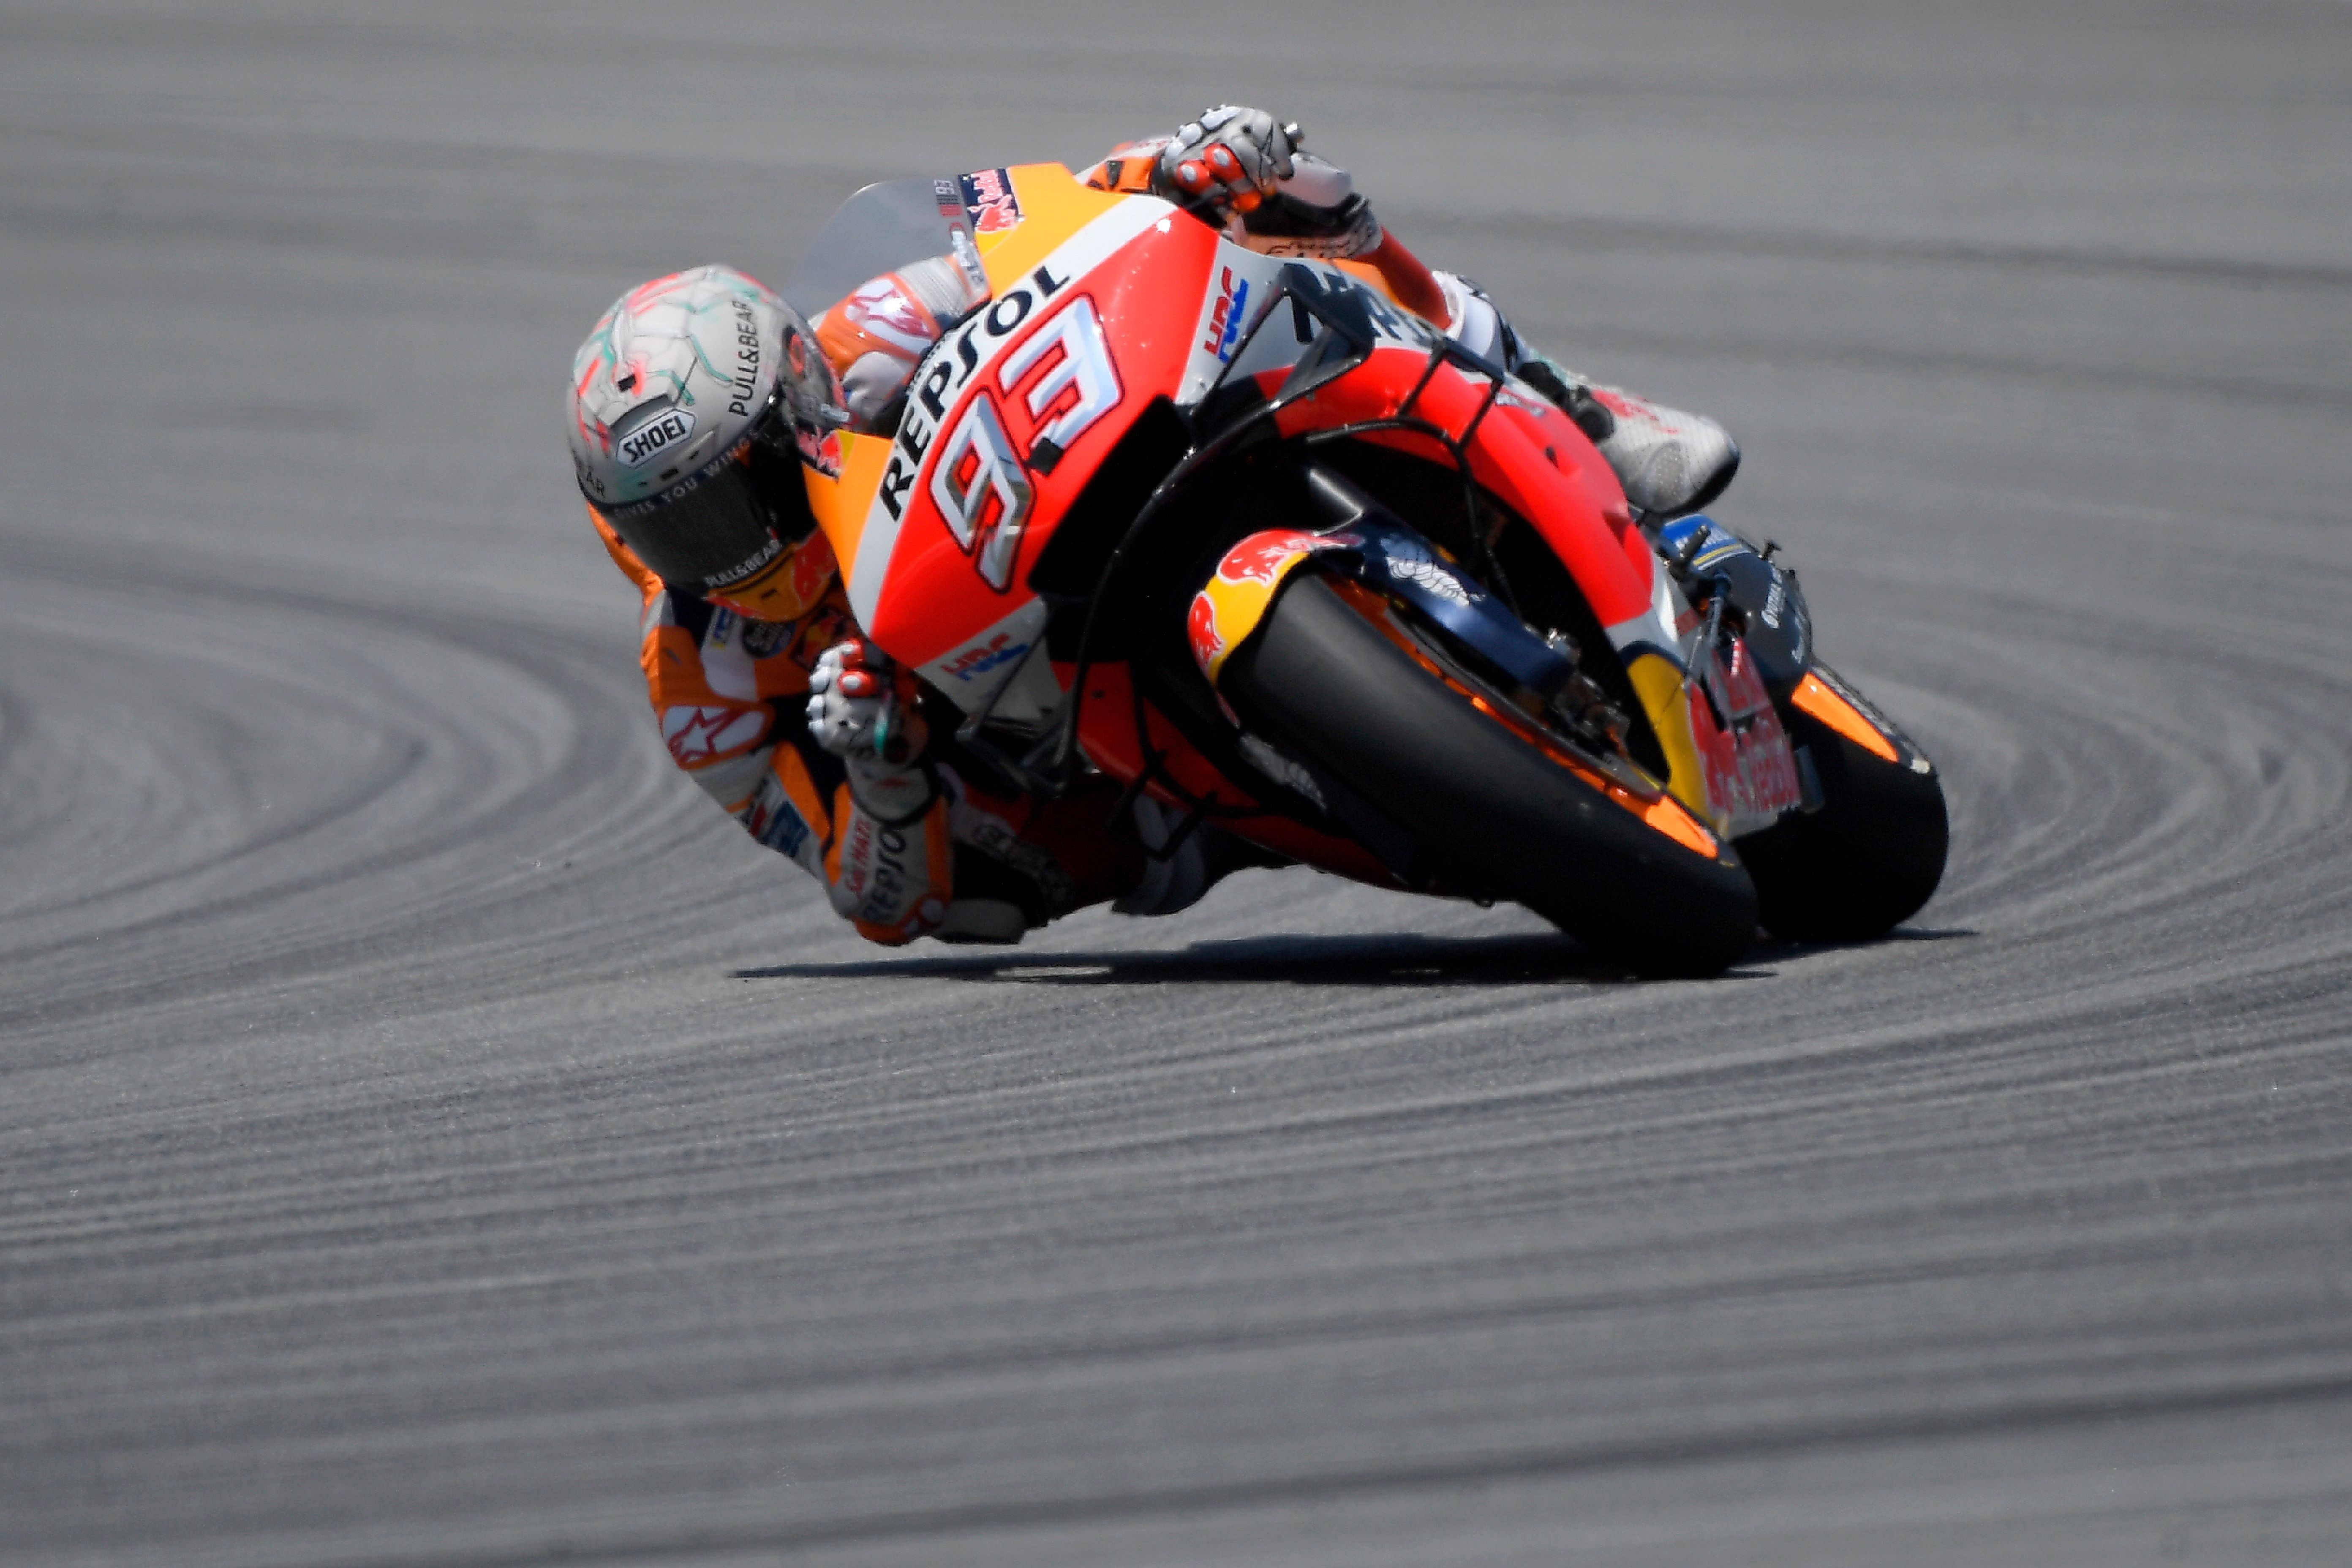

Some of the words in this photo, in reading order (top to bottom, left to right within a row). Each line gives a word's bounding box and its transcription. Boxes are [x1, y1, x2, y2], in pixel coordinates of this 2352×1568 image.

[729, 299, 759, 417] PULL&BEAR
[1204, 266, 1249, 364] HRC
[623, 415, 686, 463] SHOEI
[880, 265, 1070, 522] REPSOL
[660, 476, 697, 503] YOU
[930, 292, 1124, 593] 93
[703, 539, 782, 587] PULL&BEAR
[864, 827, 906, 922] REPSO
